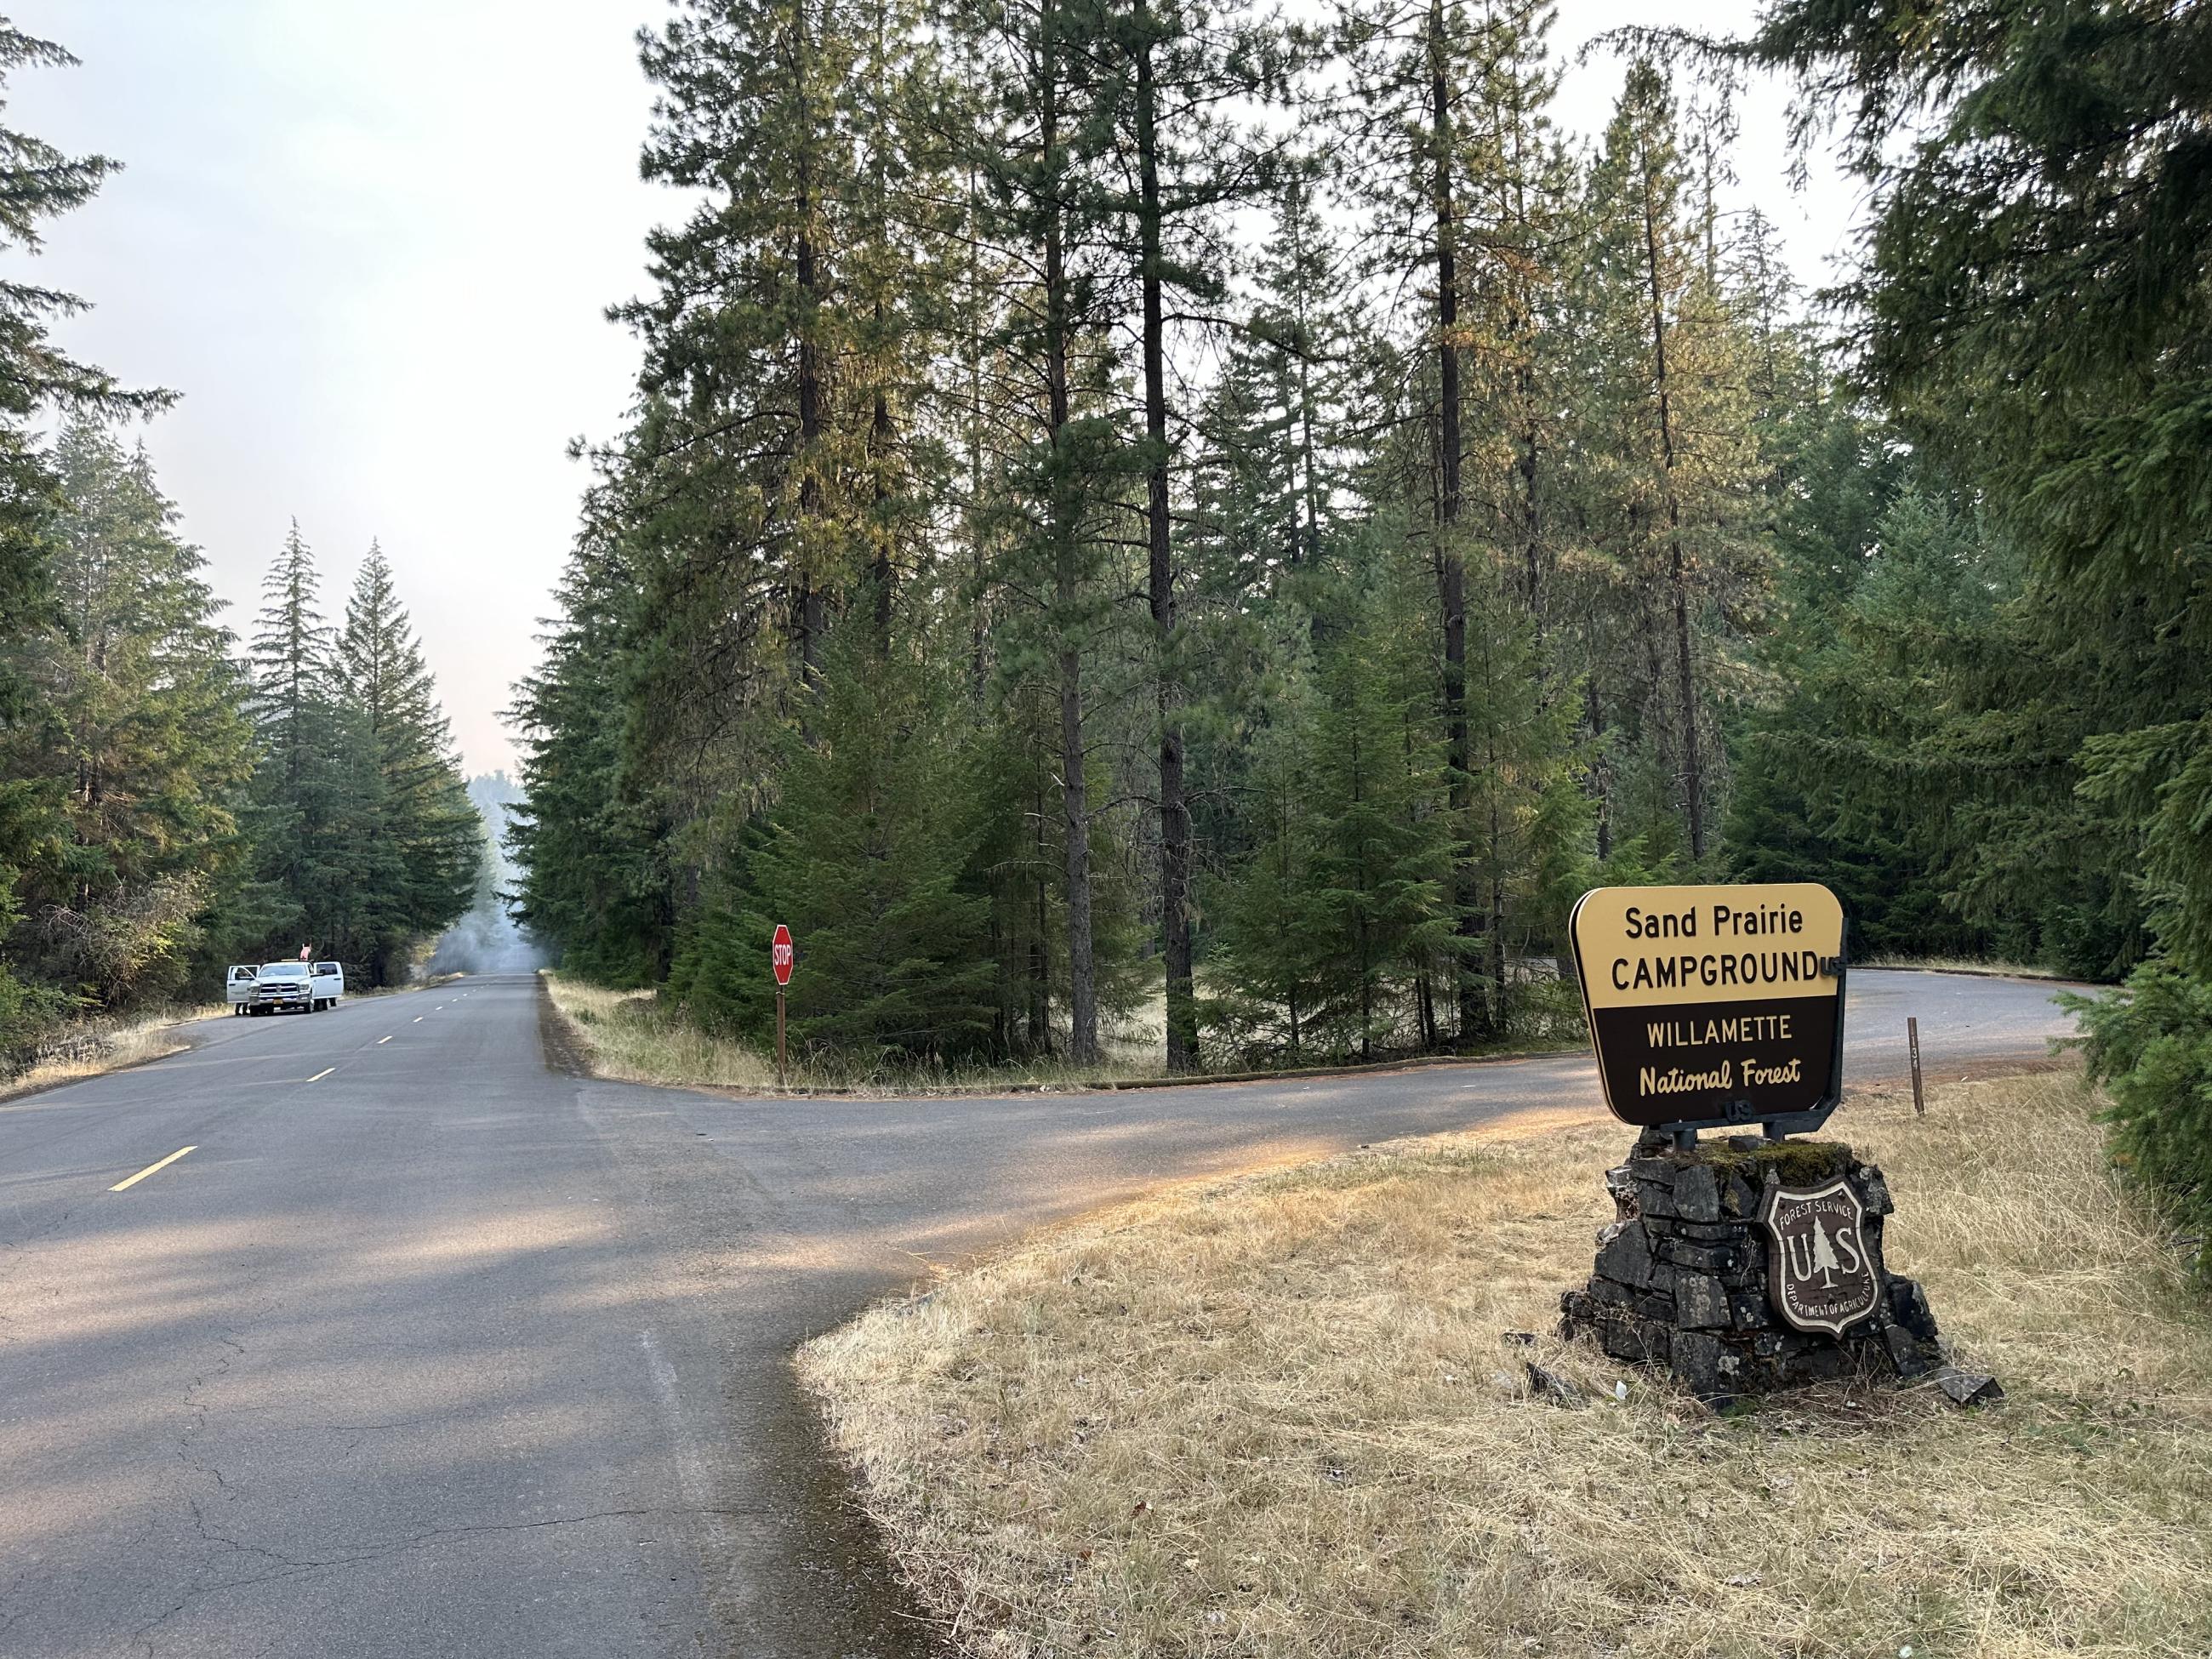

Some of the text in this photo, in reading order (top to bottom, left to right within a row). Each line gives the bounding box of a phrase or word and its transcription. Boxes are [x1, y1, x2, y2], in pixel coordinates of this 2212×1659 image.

[1625, 903, 1803, 938] Sand Prairie
[774, 944, 791, 966] STOP
[1611, 950, 1818, 990] CAMPGROUND
[1646, 1014, 1793, 1048] WILLAMETTE
[1639, 1058, 1801, 1097] National Forest
[1779, 1200, 1854, 1231] FOREST SERVICE
[1786, 1272, 1871, 1317] DEPARTMENT OF AGRICULTURE
